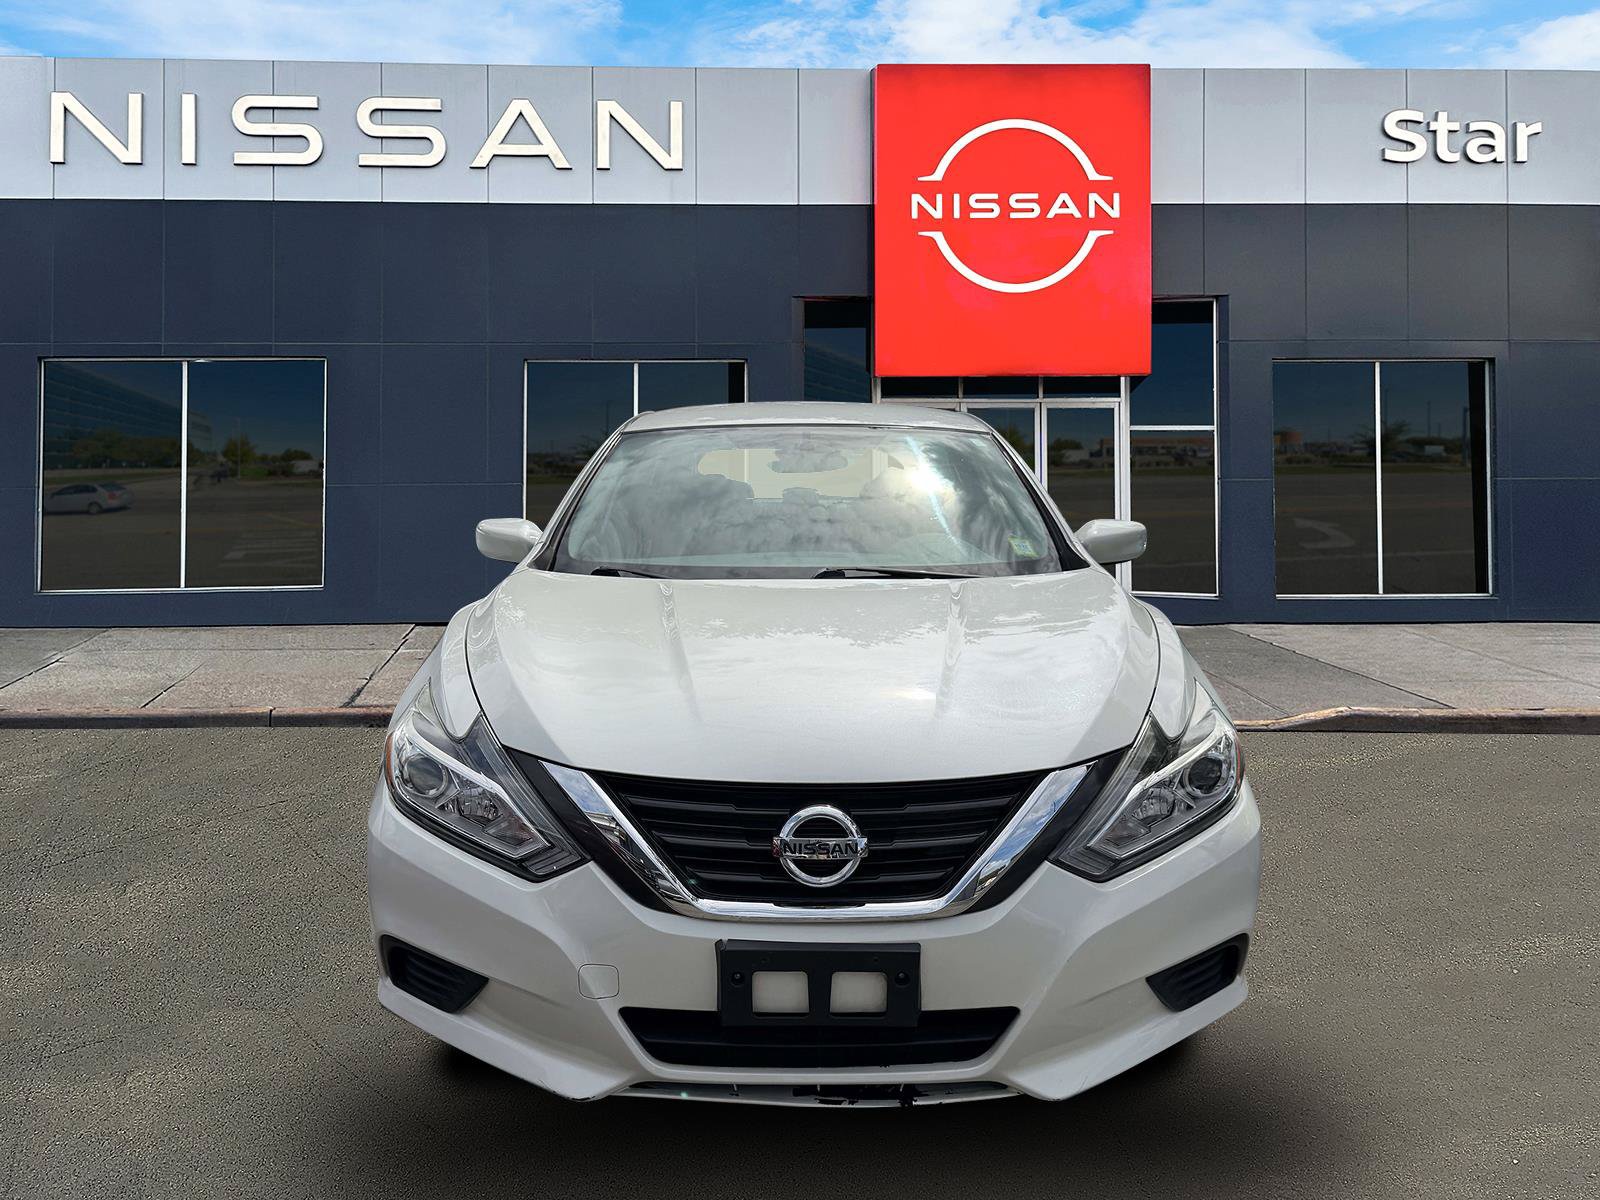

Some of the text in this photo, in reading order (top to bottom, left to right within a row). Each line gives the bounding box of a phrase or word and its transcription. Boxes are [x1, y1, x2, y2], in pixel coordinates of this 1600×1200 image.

[50, 91, 683, 171] NISSAN
[1381, 109, 1543, 164] Star
[911, 192, 1121, 220] NISSAN
[782, 841, 858, 855] NISSAN
